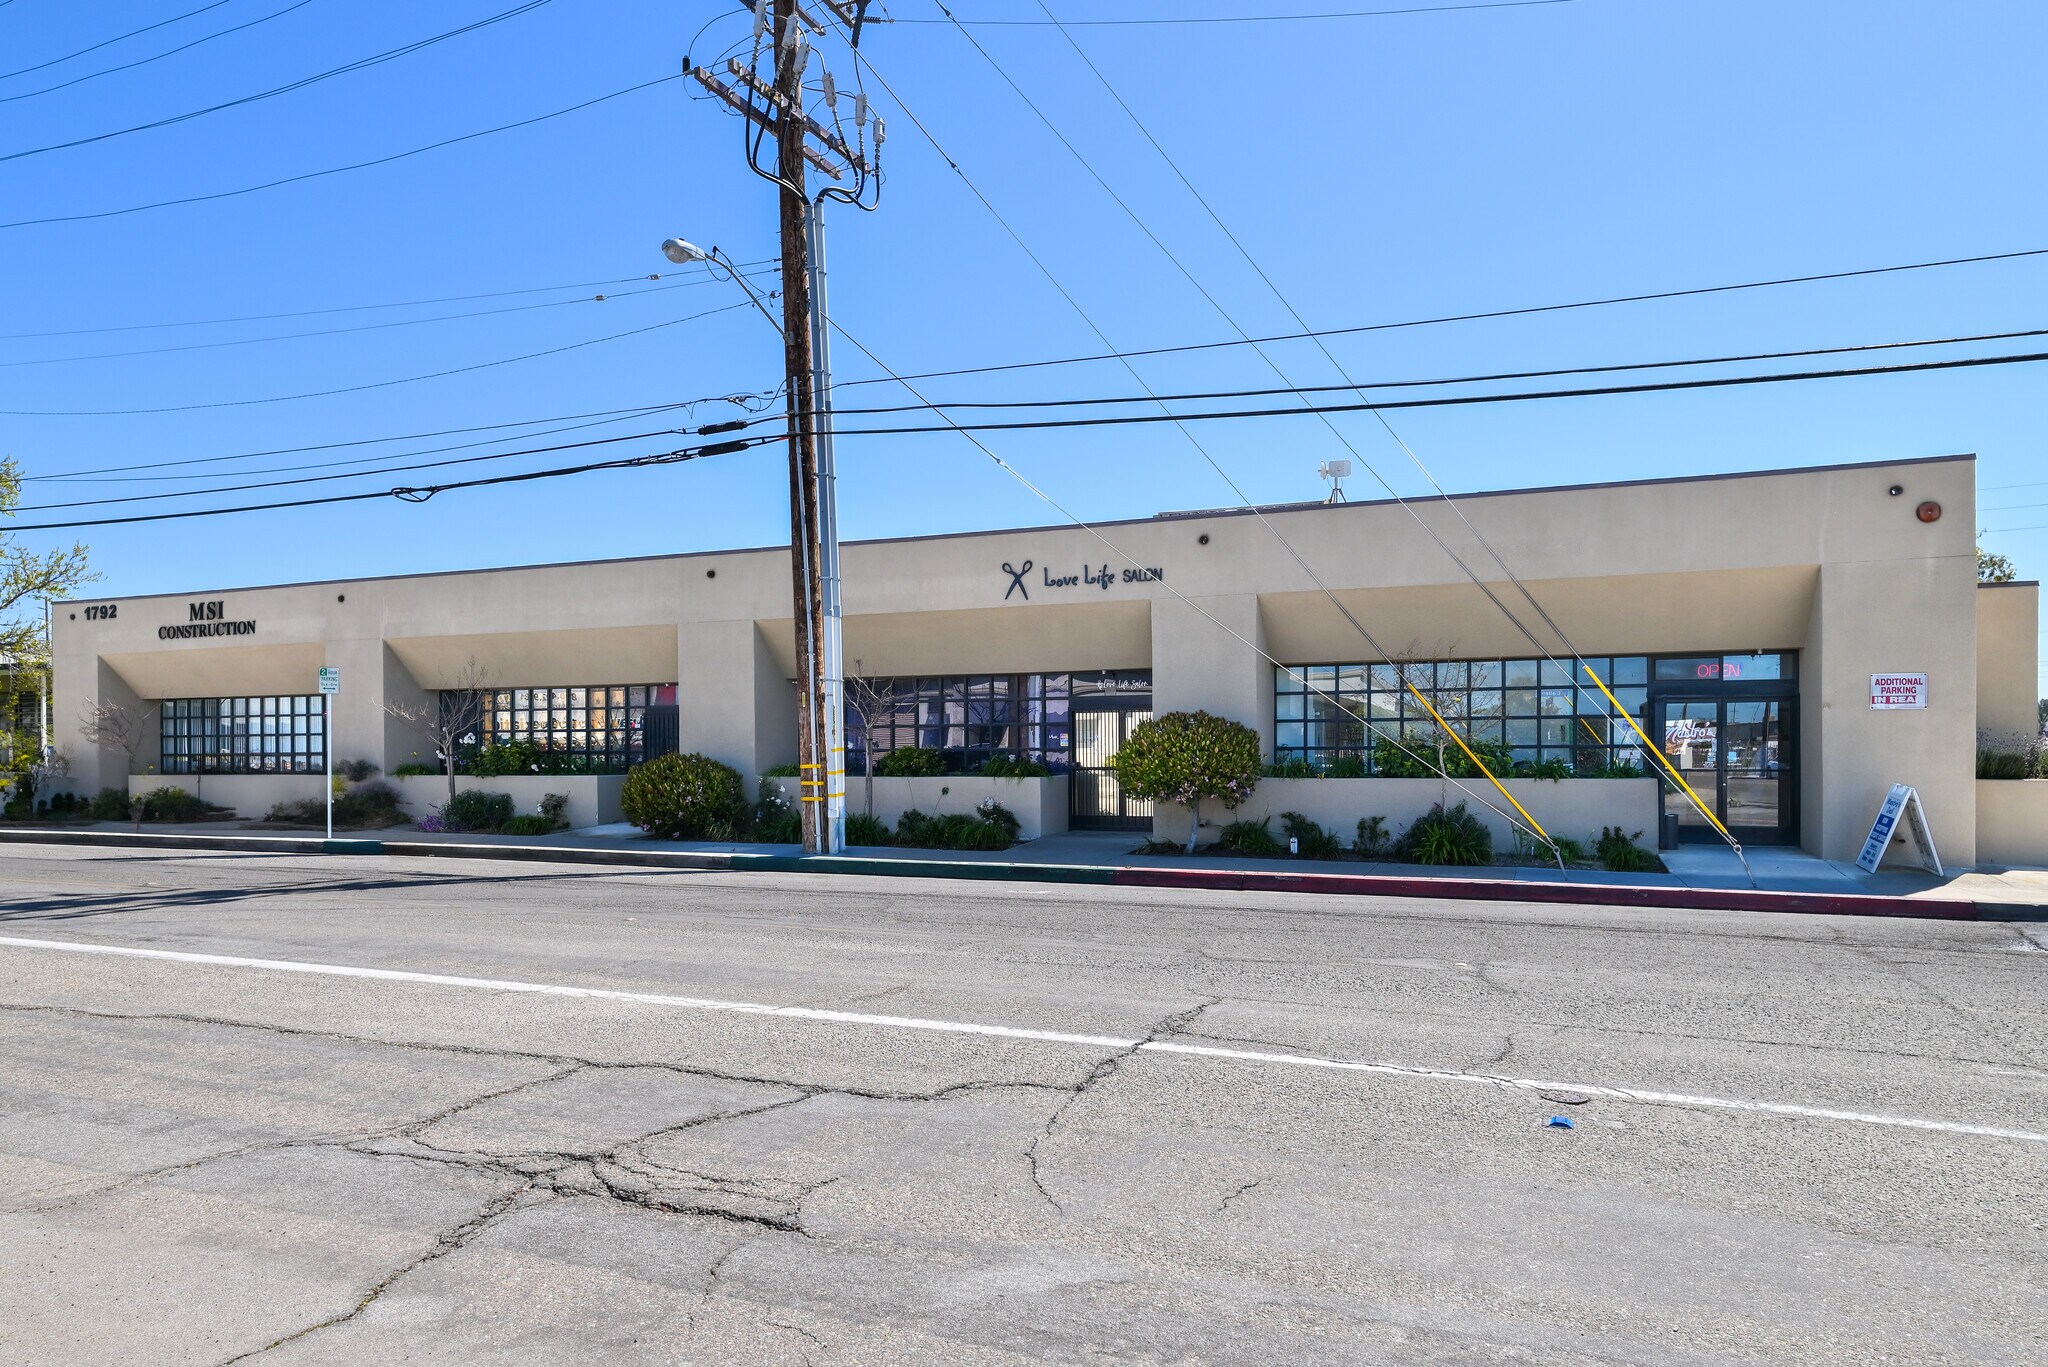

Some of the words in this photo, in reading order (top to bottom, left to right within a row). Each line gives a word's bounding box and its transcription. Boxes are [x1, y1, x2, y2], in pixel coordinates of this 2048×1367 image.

[1043, 566, 1080, 588] Love
[1084, 563, 1116, 590] Life
[1122, 567, 1163, 584] SALON
[84, 604, 118, 621] 1792
[188, 600, 225, 622] MSI
[158, 619, 257, 640] CONSTRUCTION
[1697, 663, 1741, 678] OPEN
[1875, 677, 1924, 686] ADDITIONAL
[1881, 686, 1917, 695] PARKING
[1873, 695, 1887, 704] IN
